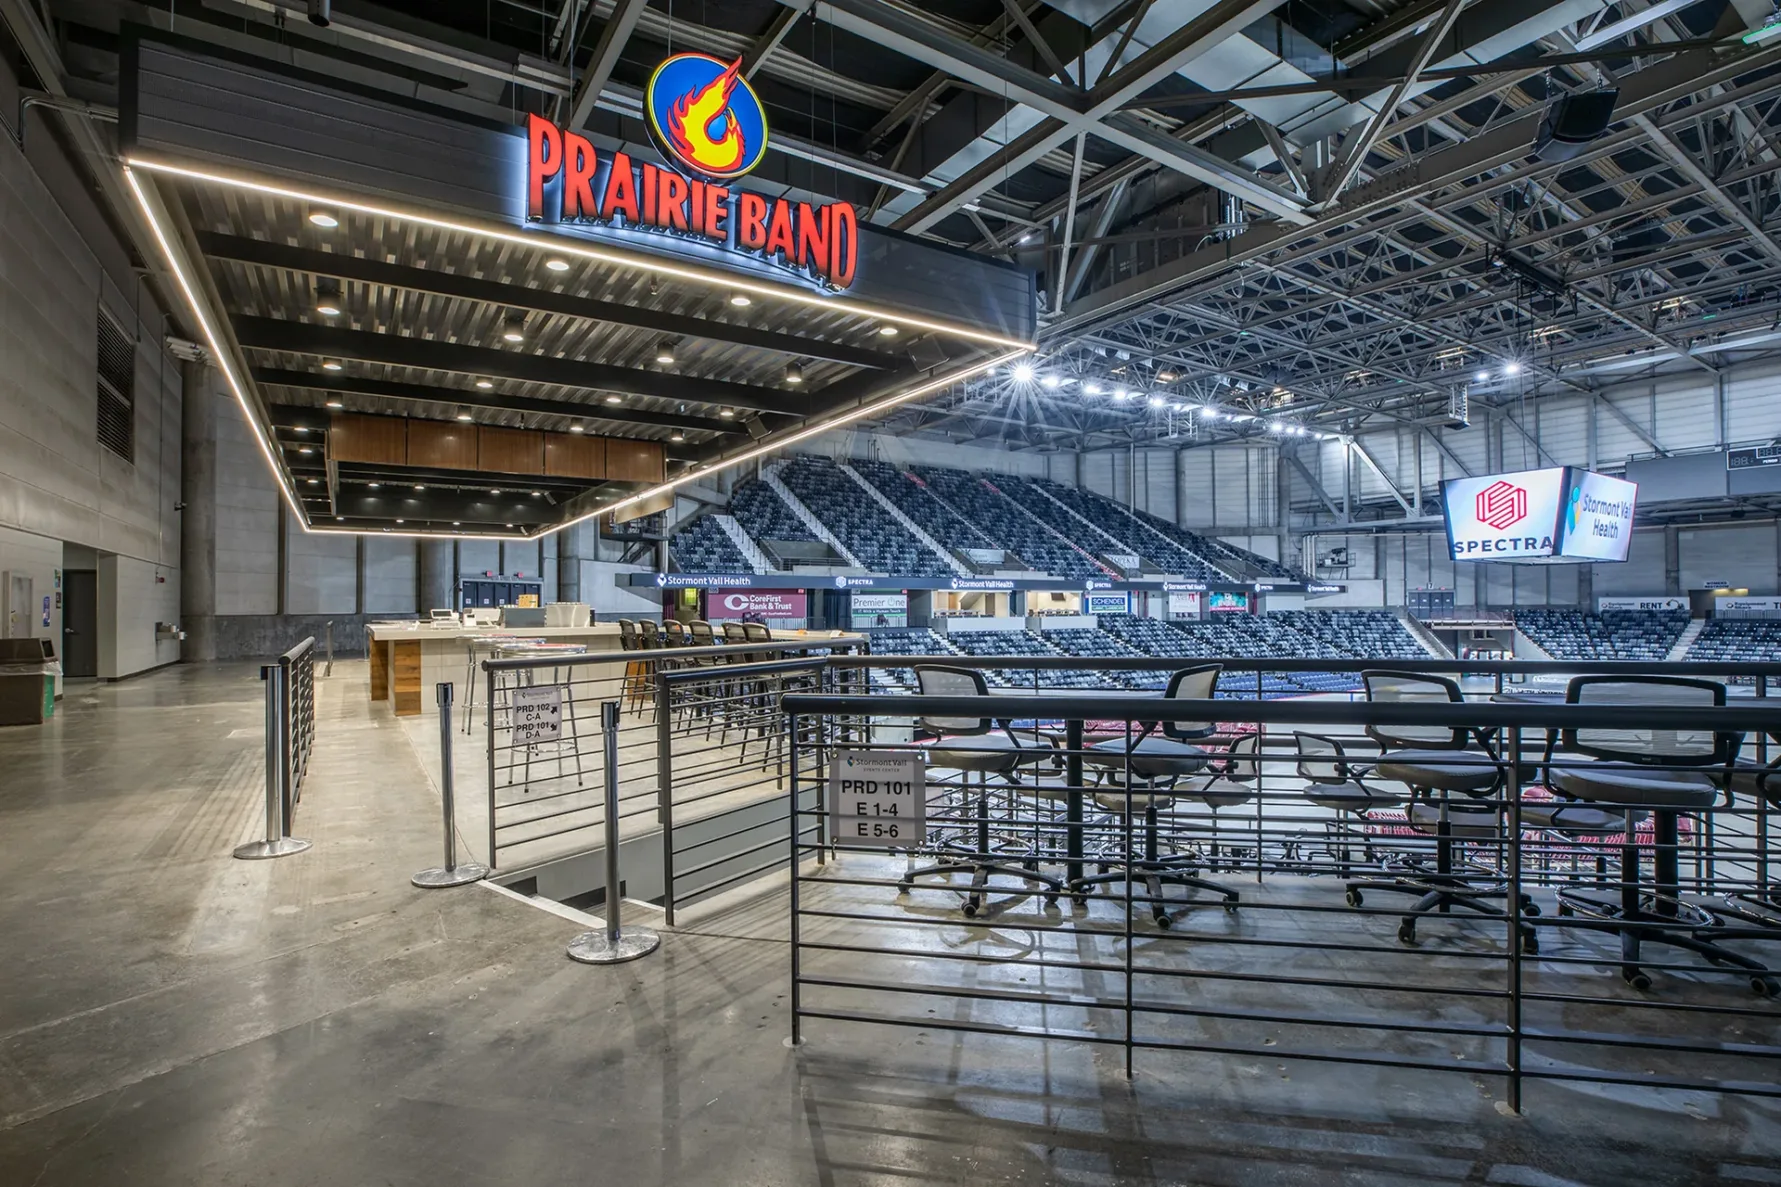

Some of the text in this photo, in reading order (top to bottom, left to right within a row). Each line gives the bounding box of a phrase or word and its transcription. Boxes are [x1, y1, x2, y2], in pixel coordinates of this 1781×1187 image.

[527, 111, 858, 289] PRAIRIE BAND
[1583, 493, 1620, 518] Stormont
[1592, 518, 1619, 539] Health
[1454, 536, 1554, 554] SPECTRA
[667, 576, 708, 585] Stormont
[724, 577, 751, 585] Health
[749, 594, 782, 603] CoreFirst
[853, 596, 906, 607] Premier One
[749, 602, 767, 610] Bank
[516, 703, 550, 713] PRD 102
[526, 713, 541, 721] C-A
[516, 721, 549, 732] PRD 101
[526, 730, 540, 739] D-A
[856, 758, 892, 766] Stormont
[842, 780, 911, 795] PRD 101
[857, 802, 898, 816] E 1-4
[857, 823, 899, 838] E 5-6
